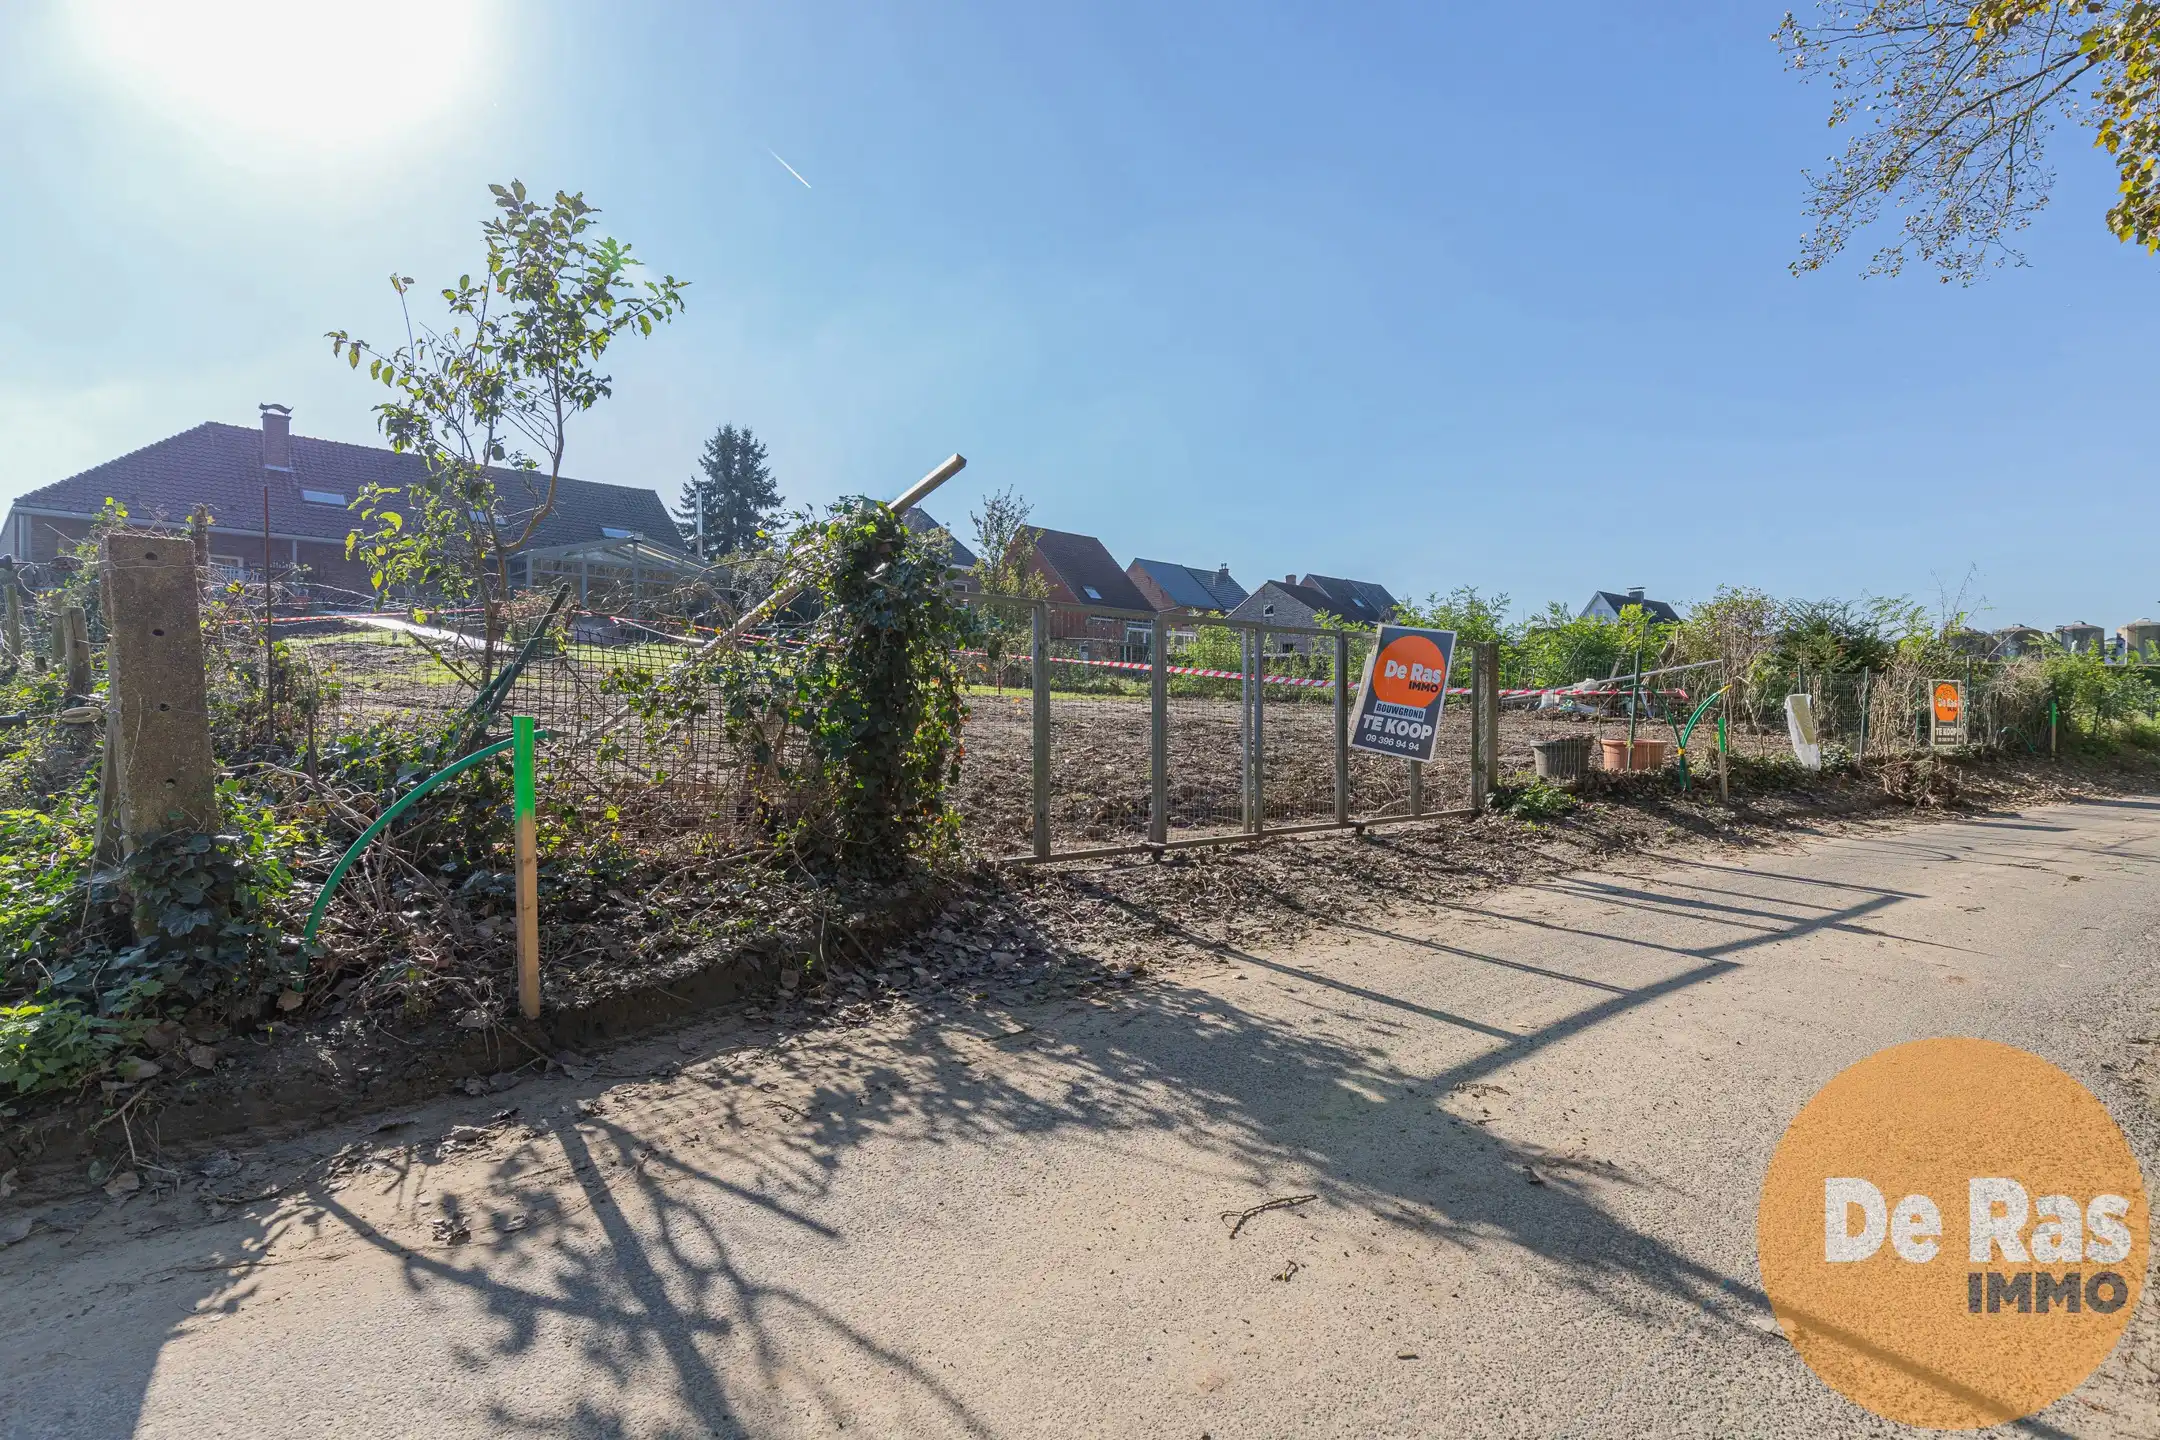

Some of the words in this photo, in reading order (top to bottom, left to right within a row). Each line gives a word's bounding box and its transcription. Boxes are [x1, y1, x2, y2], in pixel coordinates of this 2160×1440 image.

[1384, 660, 1407, 679] De
[1410, 663, 1442, 684] Ras
[1409, 681, 1438, 693] IMMO
[1376, 702, 1425, 719] BOUWGROND
[1363, 714, 1384, 731] TE
[1384, 719, 1433, 740] KOOP
[1936, 728, 1943, 736] TE
[1943, 728, 1957, 736] KOOP
[1365, 733, 1377, 742] 09
[1378, 735, 1394, 746] 396
[1395, 739, 1406, 749] 94
[1408, 742, 1420, 751] 94
